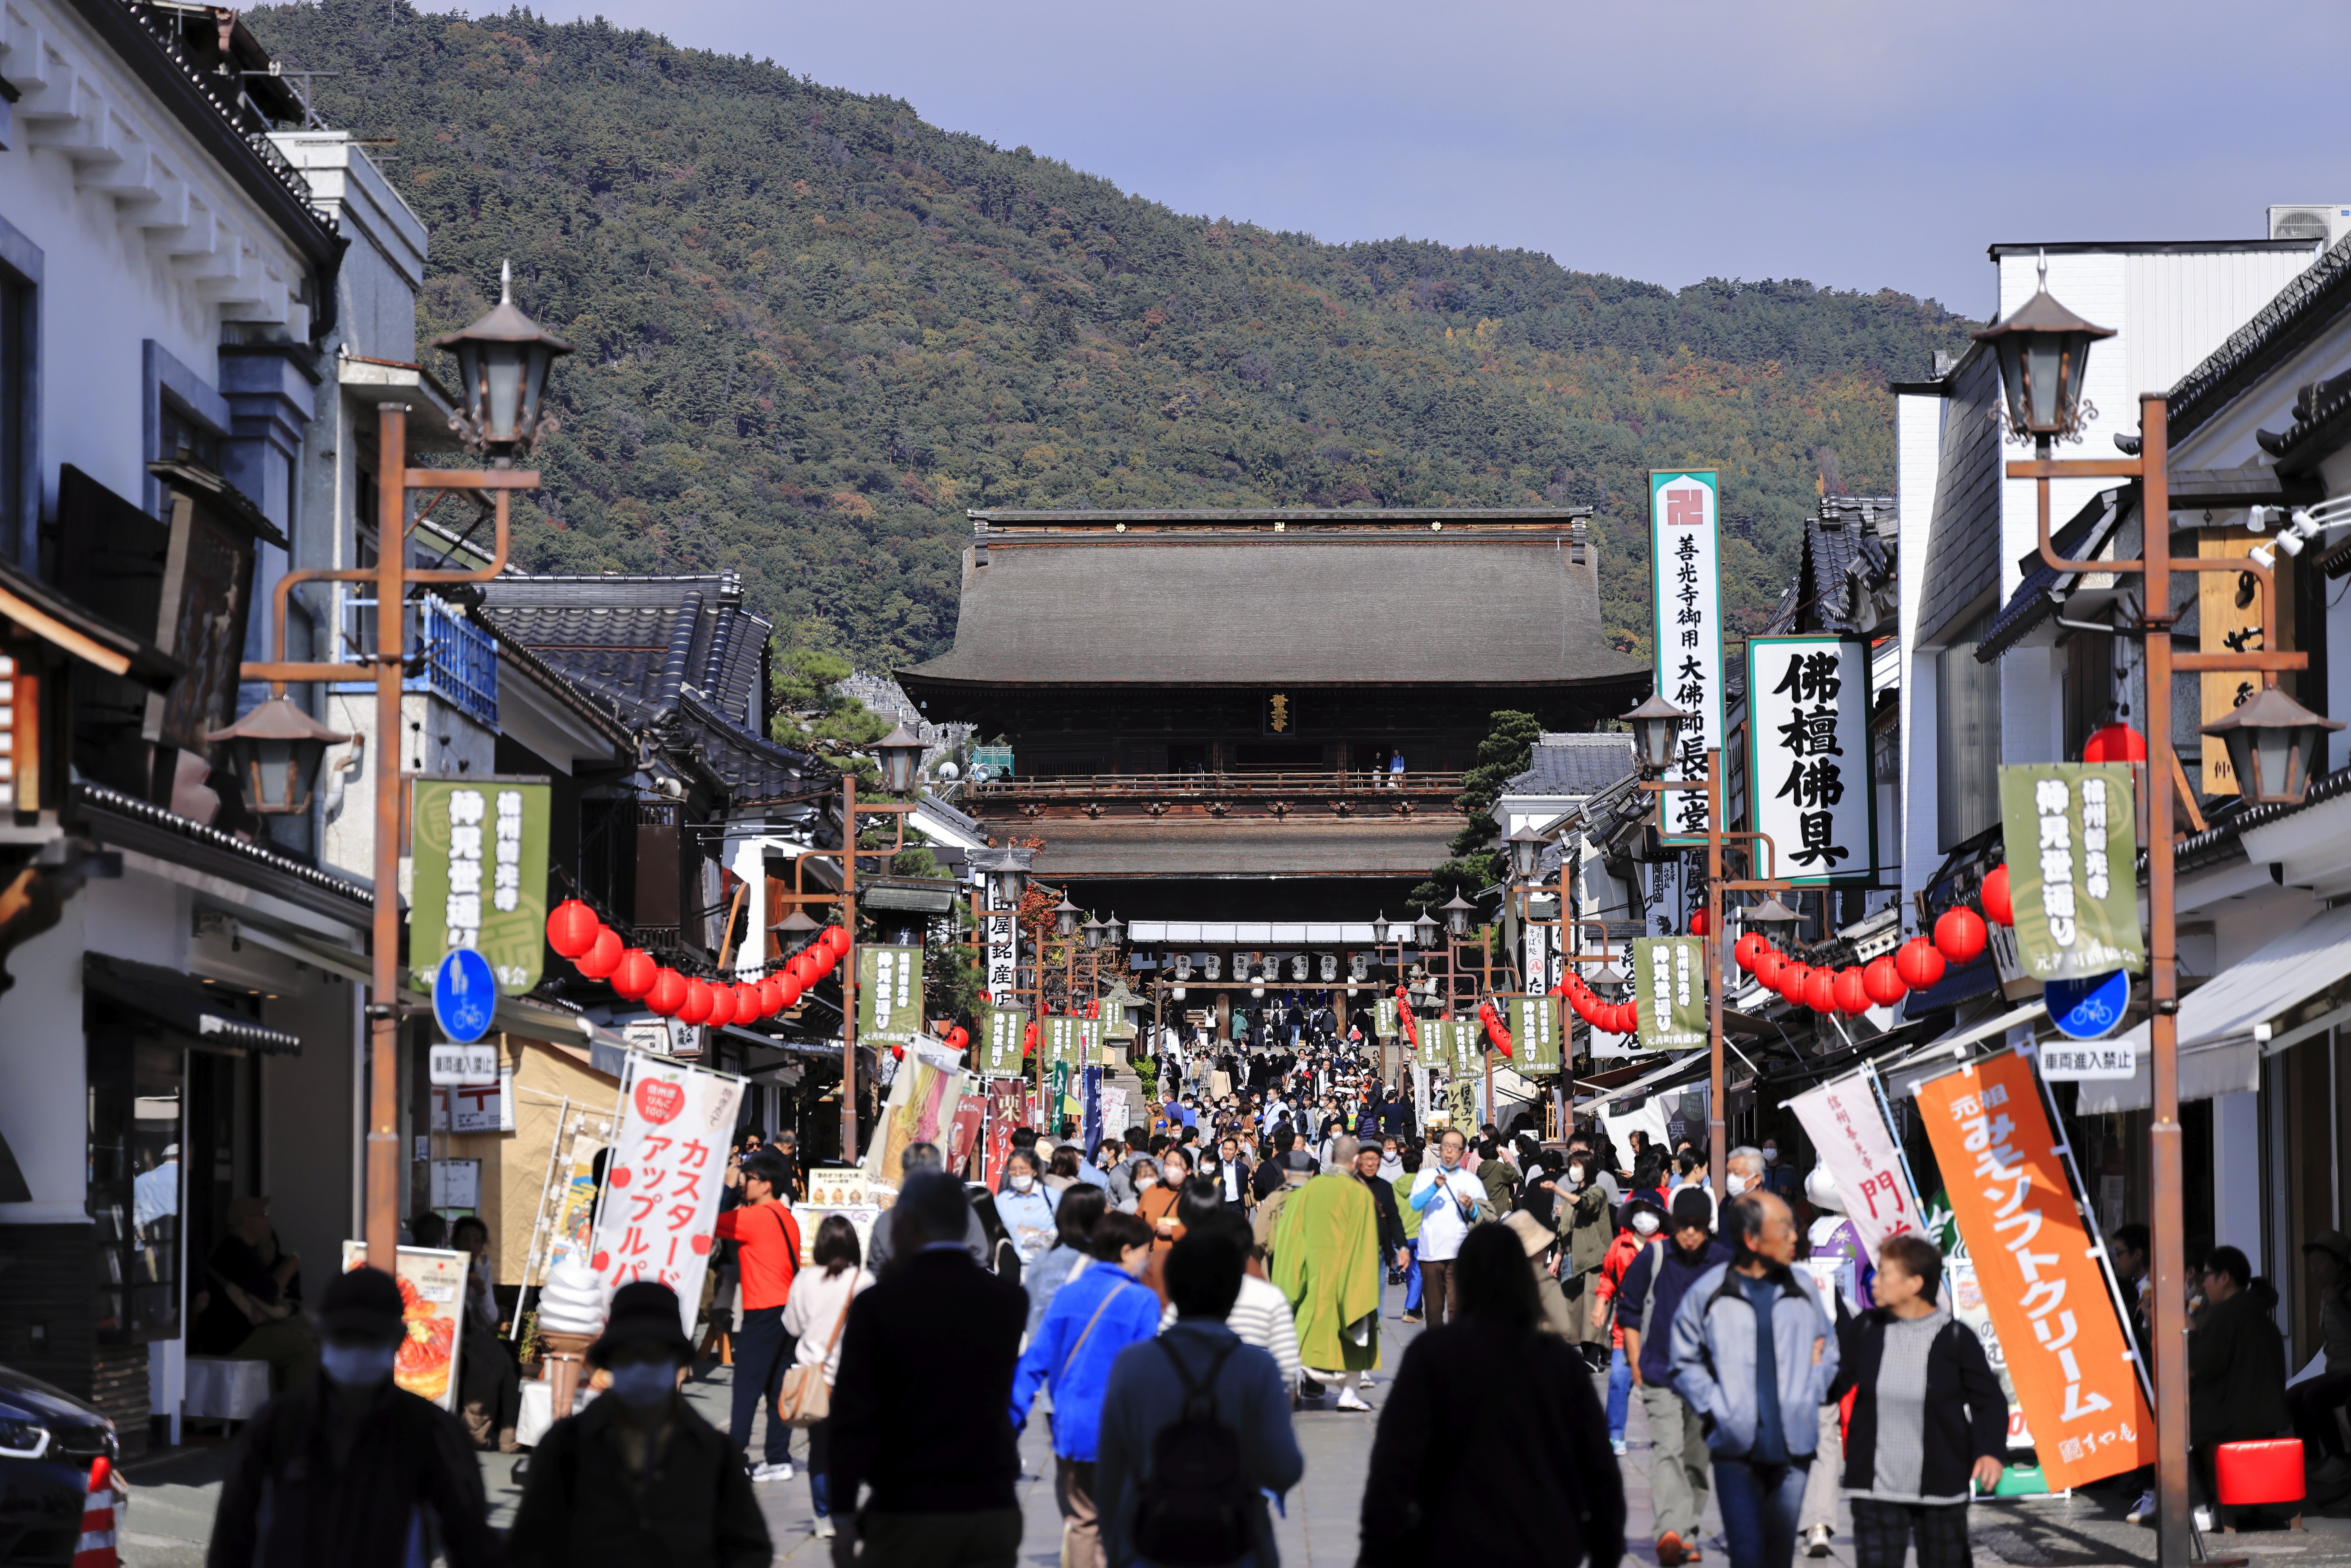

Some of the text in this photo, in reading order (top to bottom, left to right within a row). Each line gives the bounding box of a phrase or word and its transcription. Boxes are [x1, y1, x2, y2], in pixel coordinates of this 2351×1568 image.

[1773, 651, 1850, 868] 佛檀佛具
[1527, 929, 1537, 955] そば処
[897, 952, 910, 1008] 信州善光寺
[1675, 945, 1691, 1007] 信州善光寺
[1007, 1014, 1017, 1052] 信州善光寺
[1468, 1025, 1476, 1057] 信州善光寺
[1539, 1000, 1549, 1044] 信州善光寺
[2044, 1051, 2132, 1070] 車両進入禁止
[997, 1094, 1020, 1122] 栗
[1450, 1089, 1459, 1128] ソフト
[1461, 1083, 1473, 1127] はちみつ
[1949, 1083, 2009, 1121] 元祖
[1961, 1112, 2112, 1423] みそソフトクリーム
